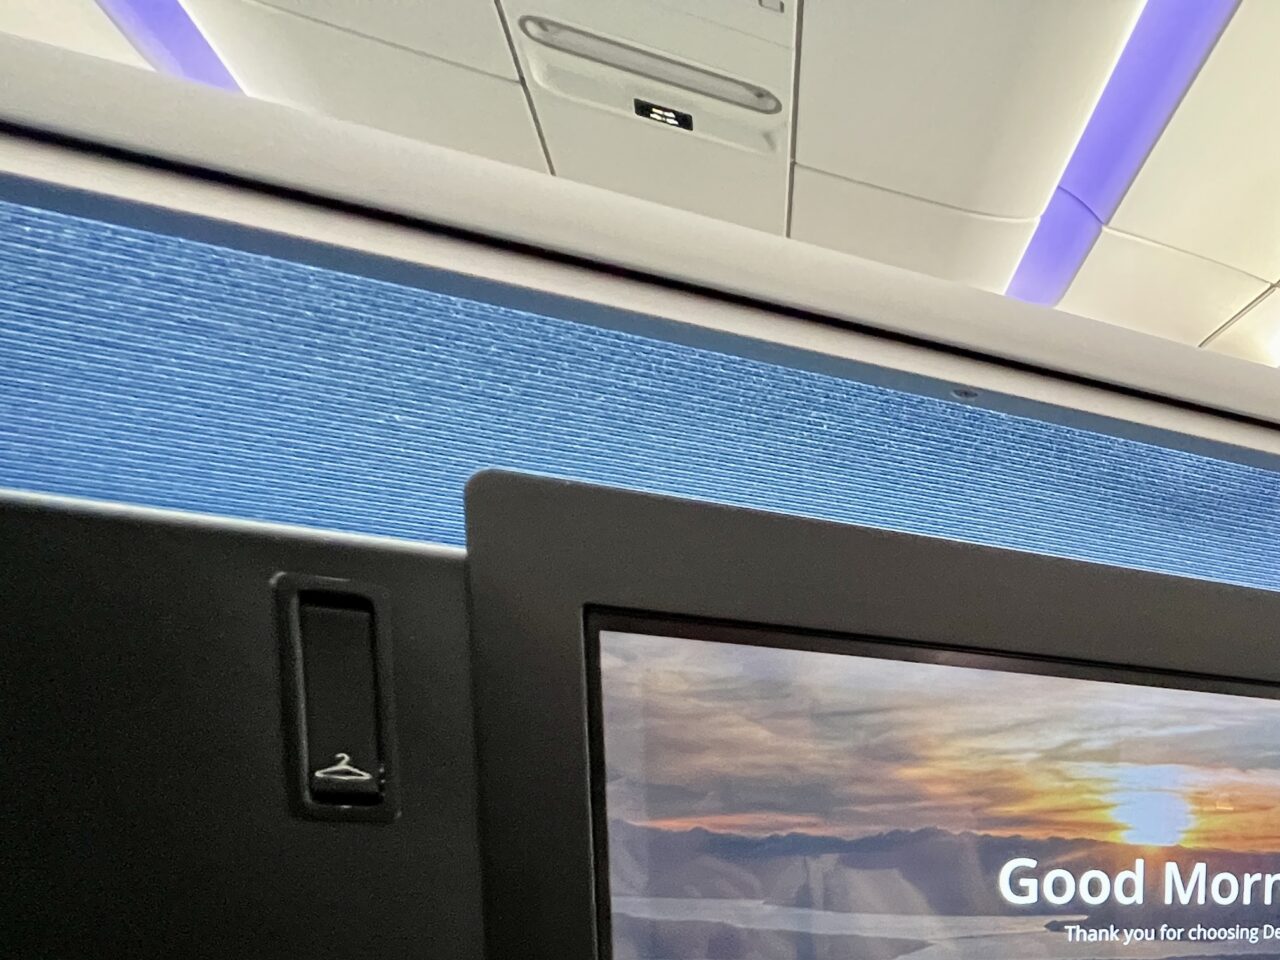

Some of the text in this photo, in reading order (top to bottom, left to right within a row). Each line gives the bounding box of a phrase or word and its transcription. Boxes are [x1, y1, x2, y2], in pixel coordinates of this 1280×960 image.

[999, 857, 1144, 905] Good
[1064, 924, 1119, 942] Thank
[1123, 928, 1155, 946] you
[1160, 924, 1184, 941] for
[1188, 924, 1259, 943] choosing
